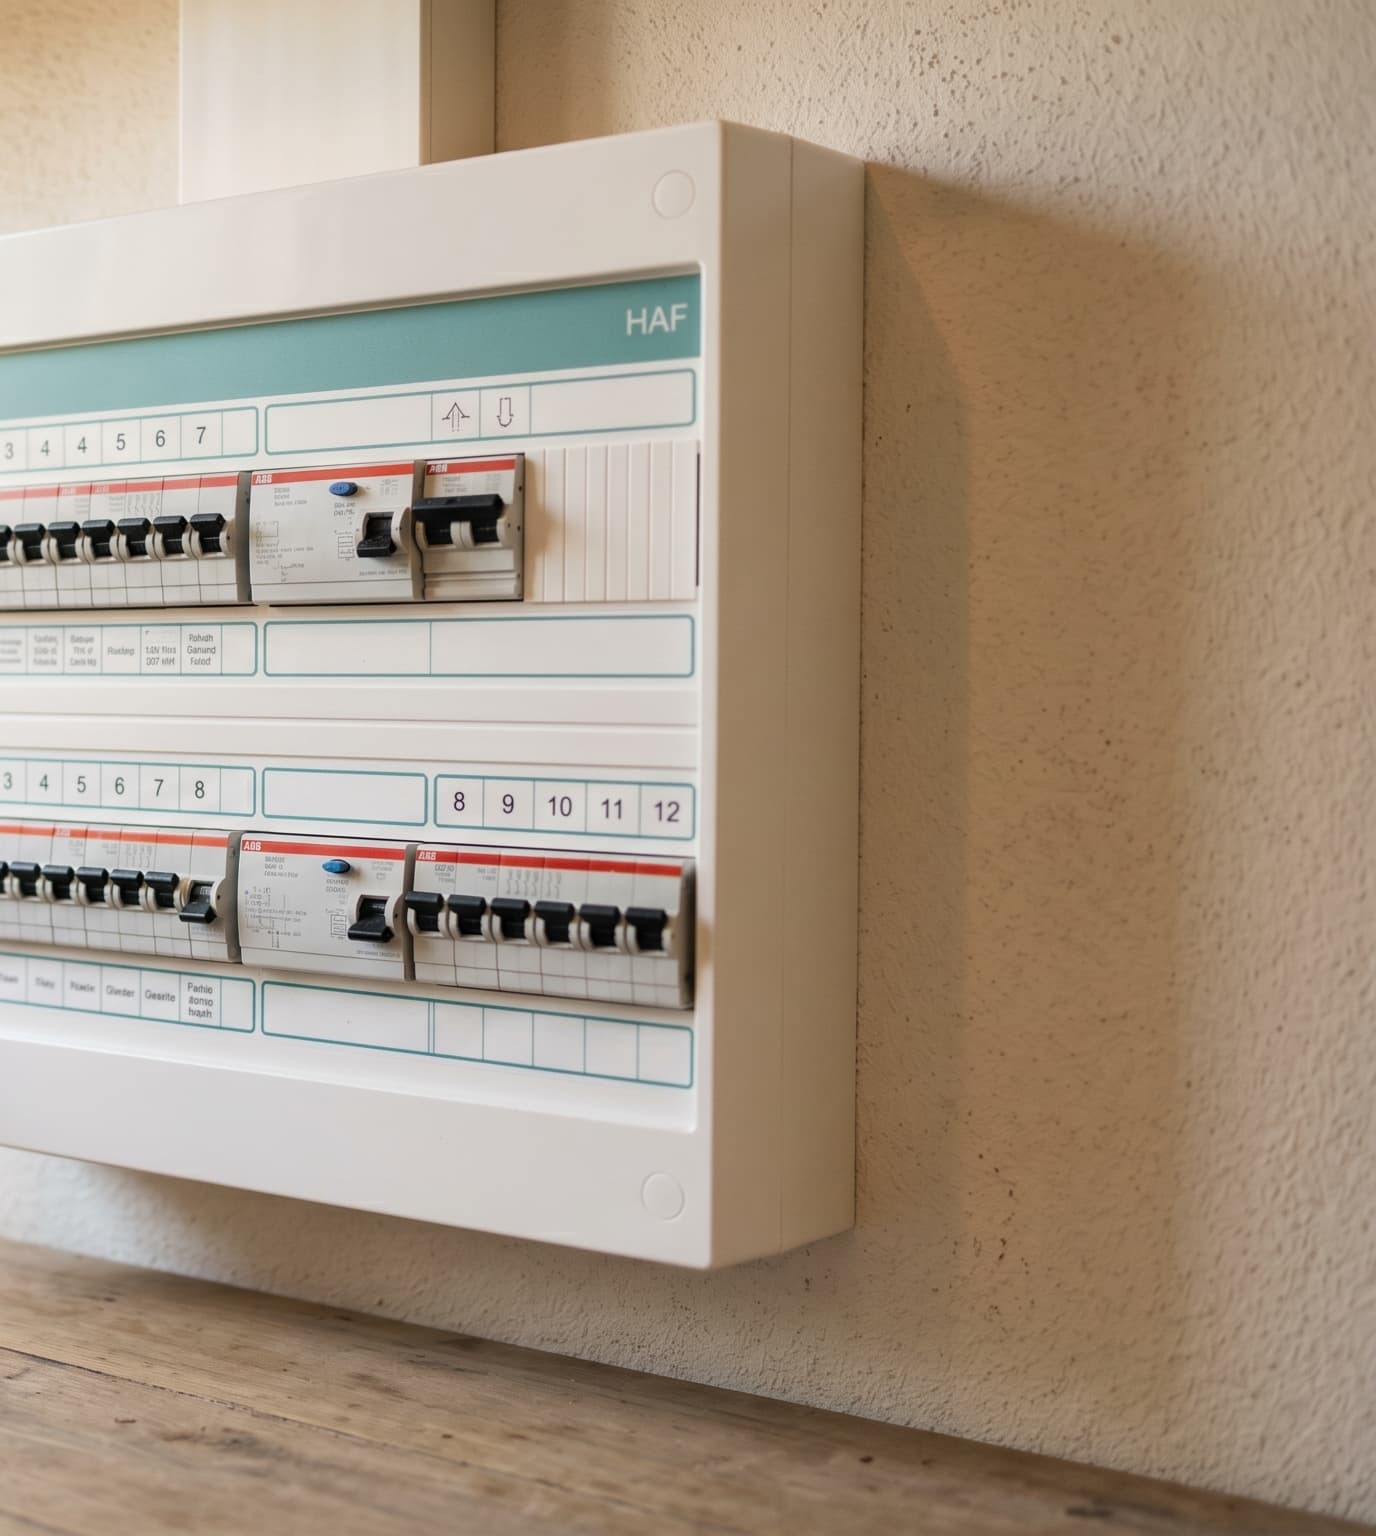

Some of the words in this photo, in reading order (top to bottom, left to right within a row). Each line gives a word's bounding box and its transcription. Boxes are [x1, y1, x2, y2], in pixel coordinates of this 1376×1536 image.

[626, 303, 688, 336] HAF
[4, 442, 15, 460] 3
[40, 439, 50, 457] 4
[77, 436, 88, 453] 4
[116, 432, 126, 451] 5
[155, 429, 166, 448] 6
[196, 426, 207, 445] 7
[3, 771, 13, 790] 3
[39, 774, 49, 790] 4
[77, 775, 87, 794] 5
[114, 776, 125, 796] 6
[154, 778, 164, 797] 7
[194, 780, 205, 799] 8
[453, 791, 466, 812] 8
[502, 794, 515, 815] 9
[548, 796, 573, 817] 10
[601, 799, 622, 820] 11
[654, 801, 680, 823] 12
